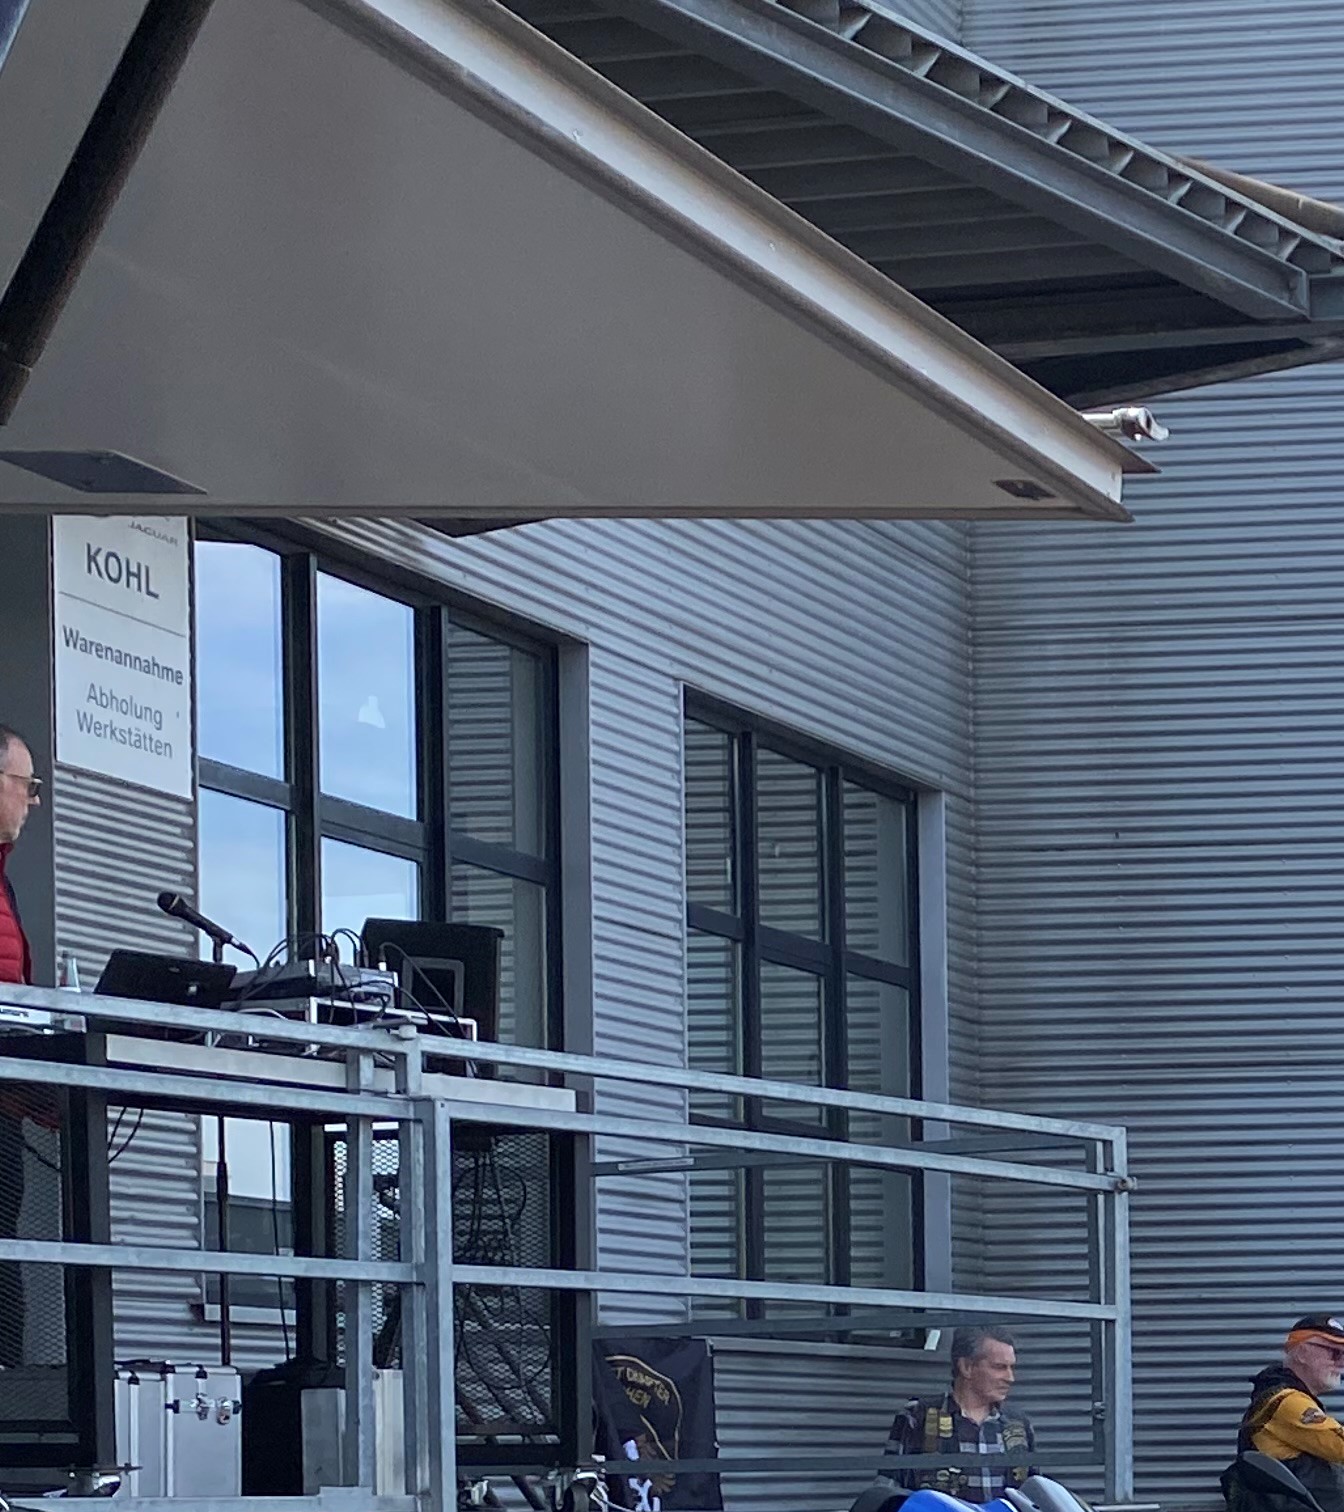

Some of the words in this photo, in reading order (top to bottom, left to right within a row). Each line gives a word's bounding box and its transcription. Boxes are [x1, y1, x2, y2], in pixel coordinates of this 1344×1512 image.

[86, 542, 160, 600] KOHL
[62, 624, 184, 685] Warenannahme
[86, 682, 163, 731] Abholung
[76, 709, 173, 759] Werkstätten
